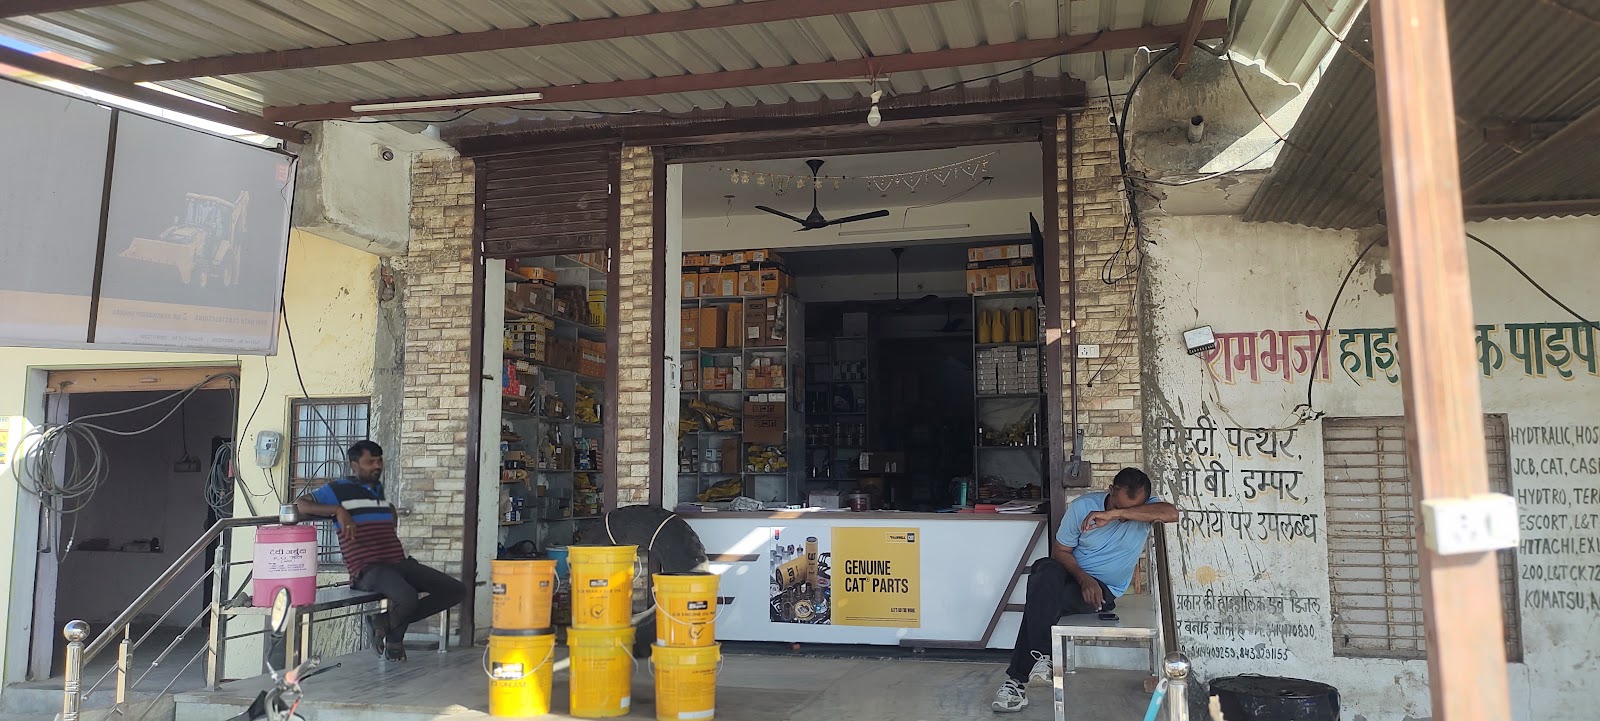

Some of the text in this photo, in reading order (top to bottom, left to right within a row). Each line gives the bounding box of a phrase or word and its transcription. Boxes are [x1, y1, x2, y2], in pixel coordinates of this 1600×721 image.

[1228, 511, 1253, 540] पर
[1257, 511, 1318, 543] उपलब्ध
[845, 559, 891, 576] GENUINE
[872, 578, 909, 594] PARTS
